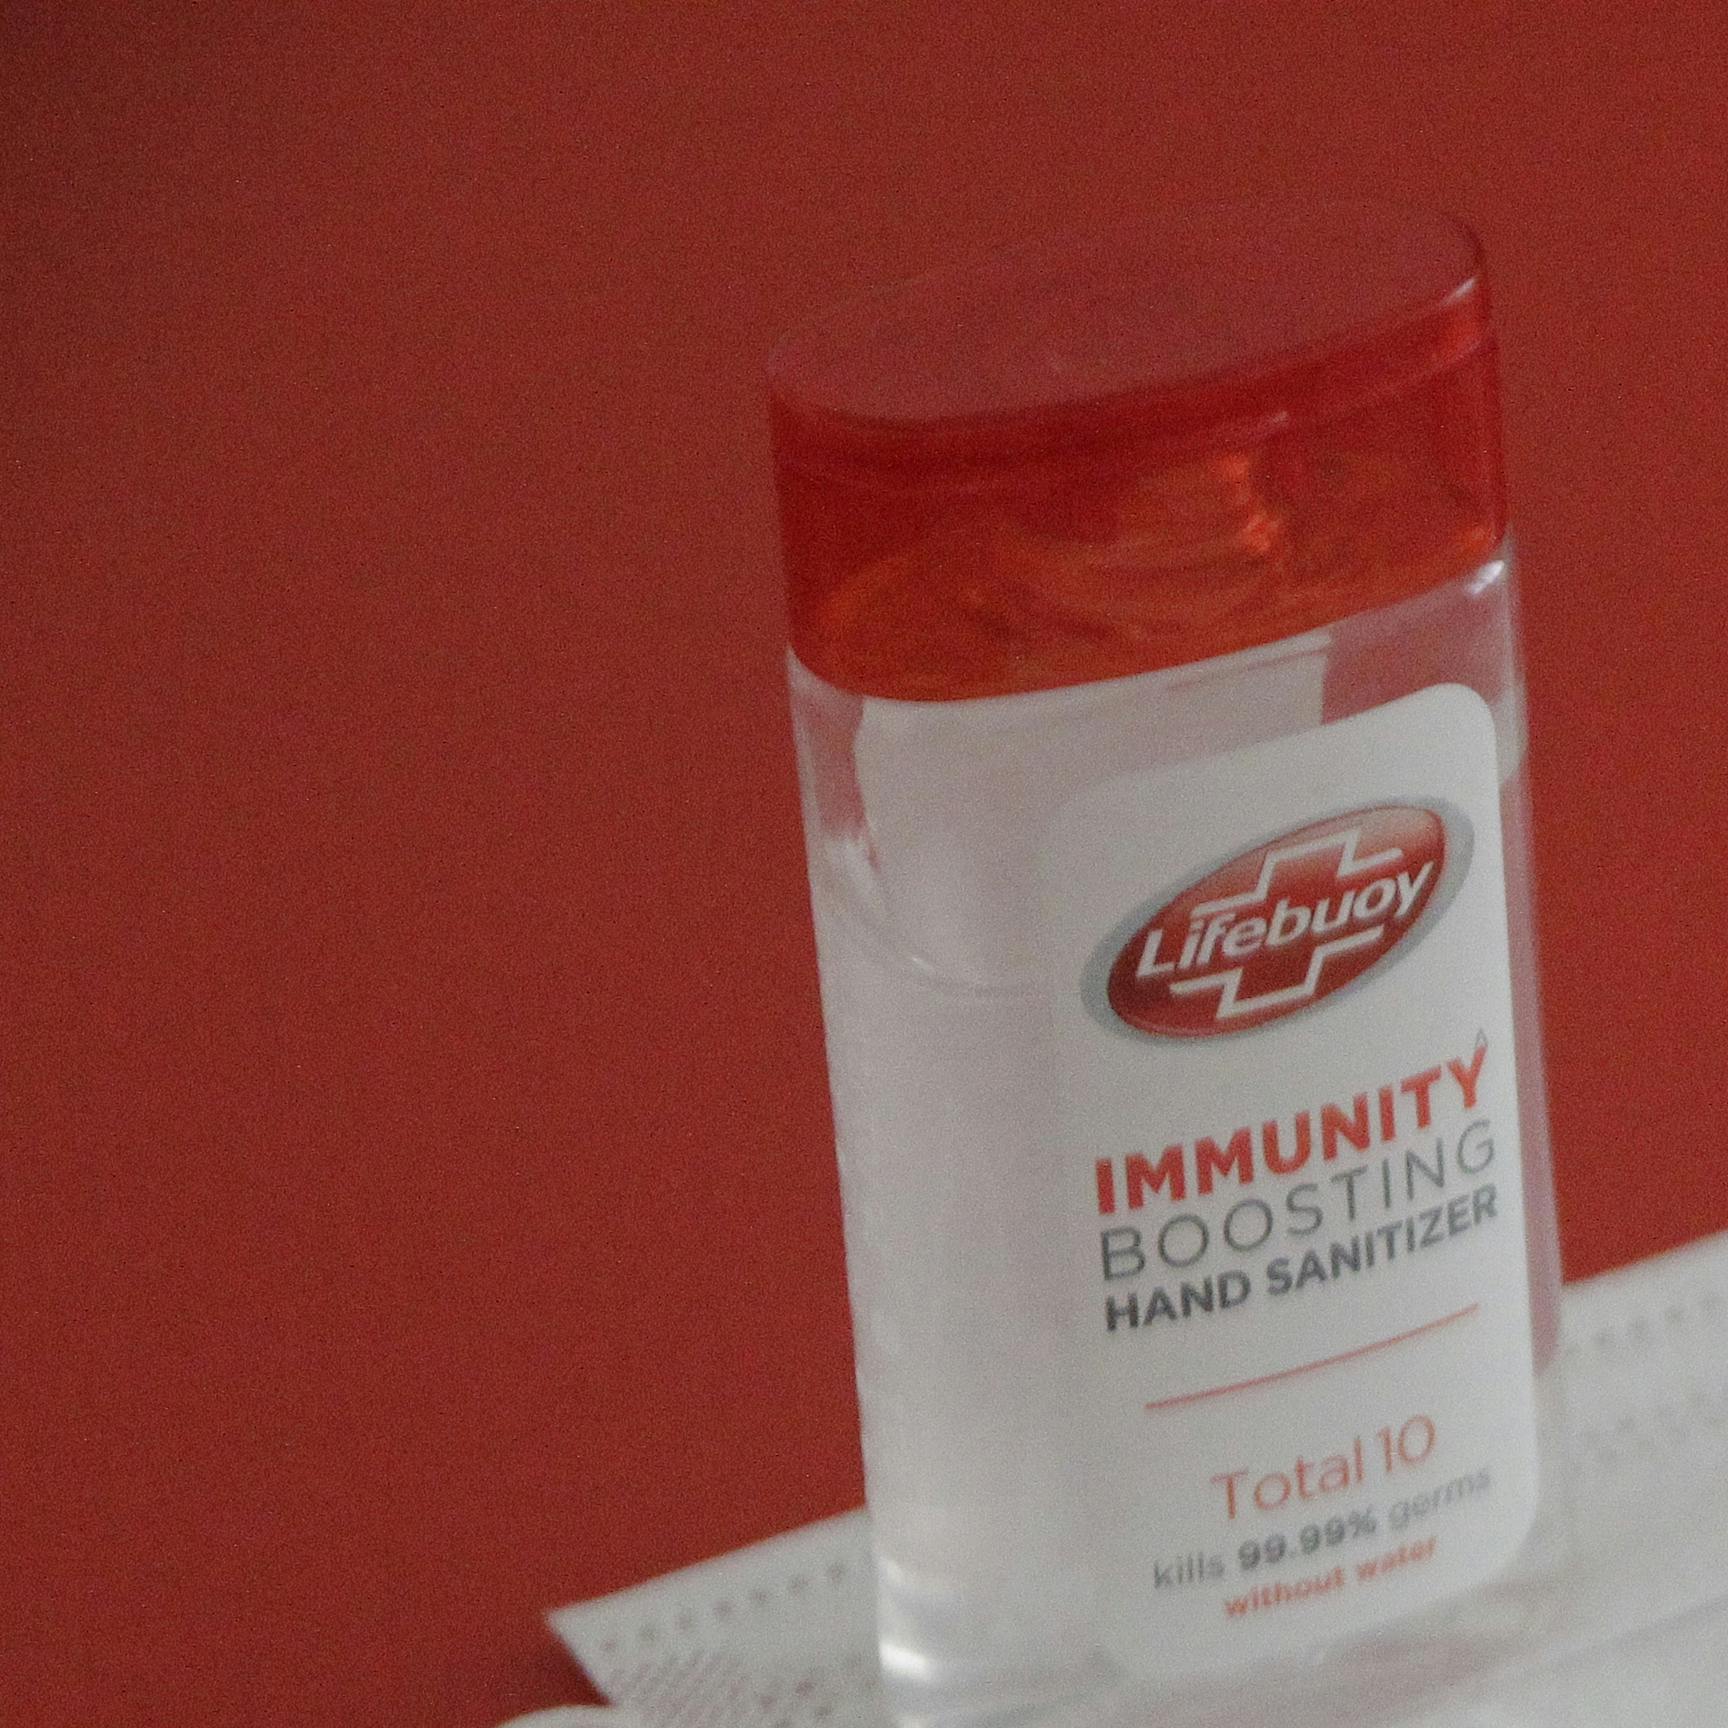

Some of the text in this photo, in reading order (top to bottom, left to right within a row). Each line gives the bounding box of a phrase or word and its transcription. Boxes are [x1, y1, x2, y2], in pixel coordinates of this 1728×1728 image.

[1135, 861, 1434, 978] Lifebuoy
[1094, 1043, 1490, 1215] IMMUNITY
[1100, 1119, 1497, 1282] BOOSTING
[1104, 1182, 1499, 1332] HAND SANITIZER
[1211, 1413, 1438, 1520] Total 10
[1153, 1467, 1492, 1590] kills 99.99% germs
[1224, 1535, 1438, 1619] without water
